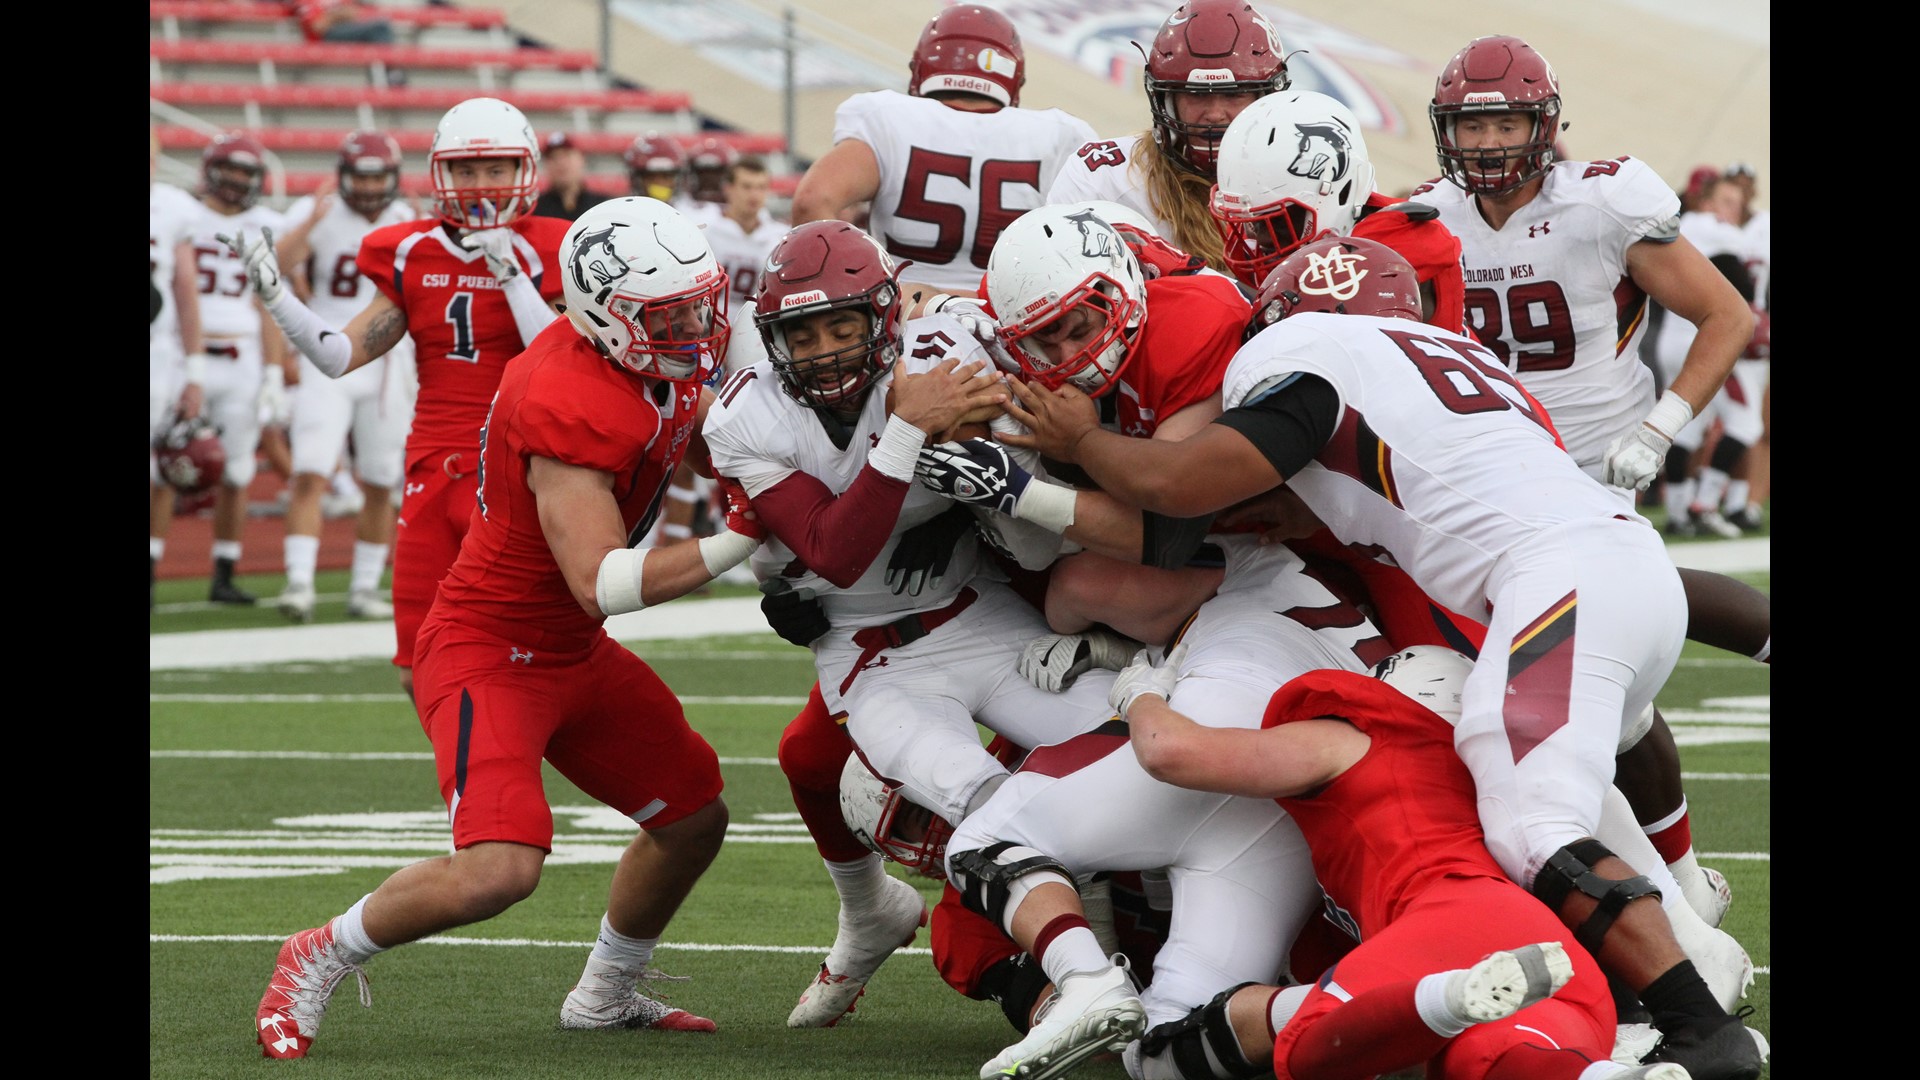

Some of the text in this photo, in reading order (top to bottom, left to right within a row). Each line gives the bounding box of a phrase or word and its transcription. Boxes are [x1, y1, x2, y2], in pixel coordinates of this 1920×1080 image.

[943, 77, 991, 93] Riddell
[885, 144, 1042, 270] 56
[422, 273, 503, 290] CSU PUEBL
[1509, 263, 1535, 280] MESA
[784, 292, 821, 307] Riddell
[1023, 296, 1049, 315] EDDIE
[444, 291, 480, 364] 1
[1464, 280, 1577, 373] 89
[1022, 350, 1052, 370] Riddell
[718, 365, 760, 410] 11
[1377, 327, 1557, 442] 65
